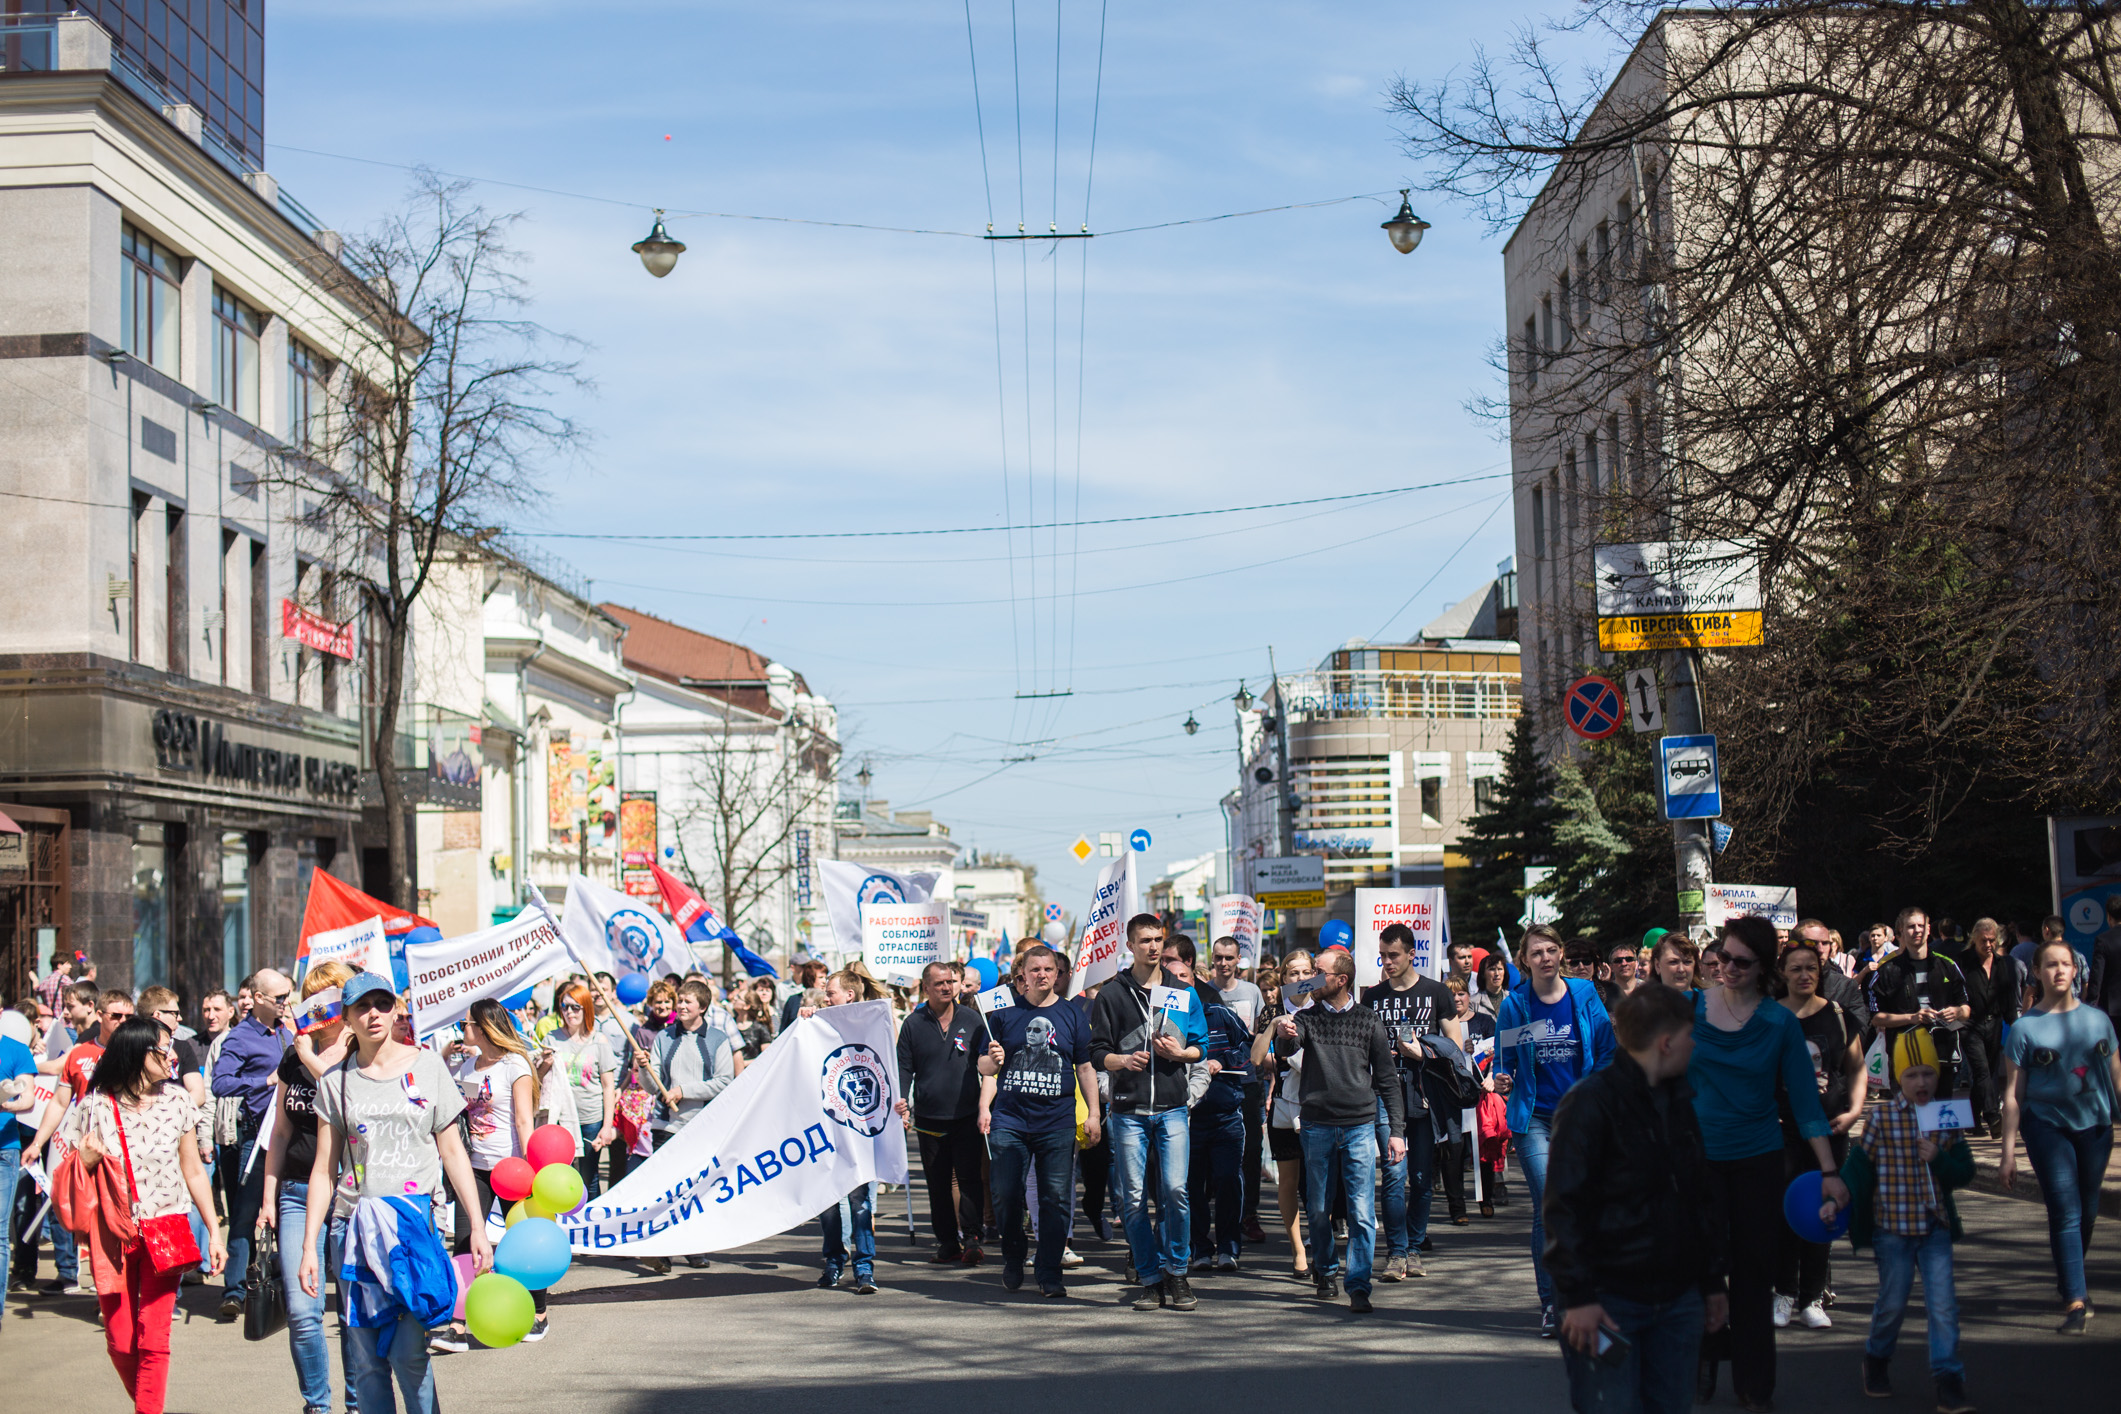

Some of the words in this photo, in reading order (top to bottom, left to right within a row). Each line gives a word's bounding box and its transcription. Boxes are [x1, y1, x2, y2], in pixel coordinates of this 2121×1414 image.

[1669, 583, 1698, 592] мост
[1636, 591, 1735, 608] КАНАВИНСКИЙ
[1630, 616, 1732, 633] ПЕРСПЕКТИВА
[1271, 876, 1322, 885] ПОКРОВСКАЯ
[1711, 887, 1760, 899] ЗАРПЛАТА.
[1723, 899, 1782, 912] ЗАНЯТОСТЬ.
[882, 928, 936, 939] СОБЛЮДАЙ
[879, 942, 938, 952] ОТРАСЛЕВОЕ
[1373, 996, 1432, 1011] BERLIN
[1006, 1070, 1063, 1084] САМЫЙ
[1004, 1078, 1062, 1090] ВЕЖЛИВЫЙ
[1020, 1085, 1062, 1097] ЛЮДЕЙ
[711, 1122, 835, 1204] ЗАВОД
